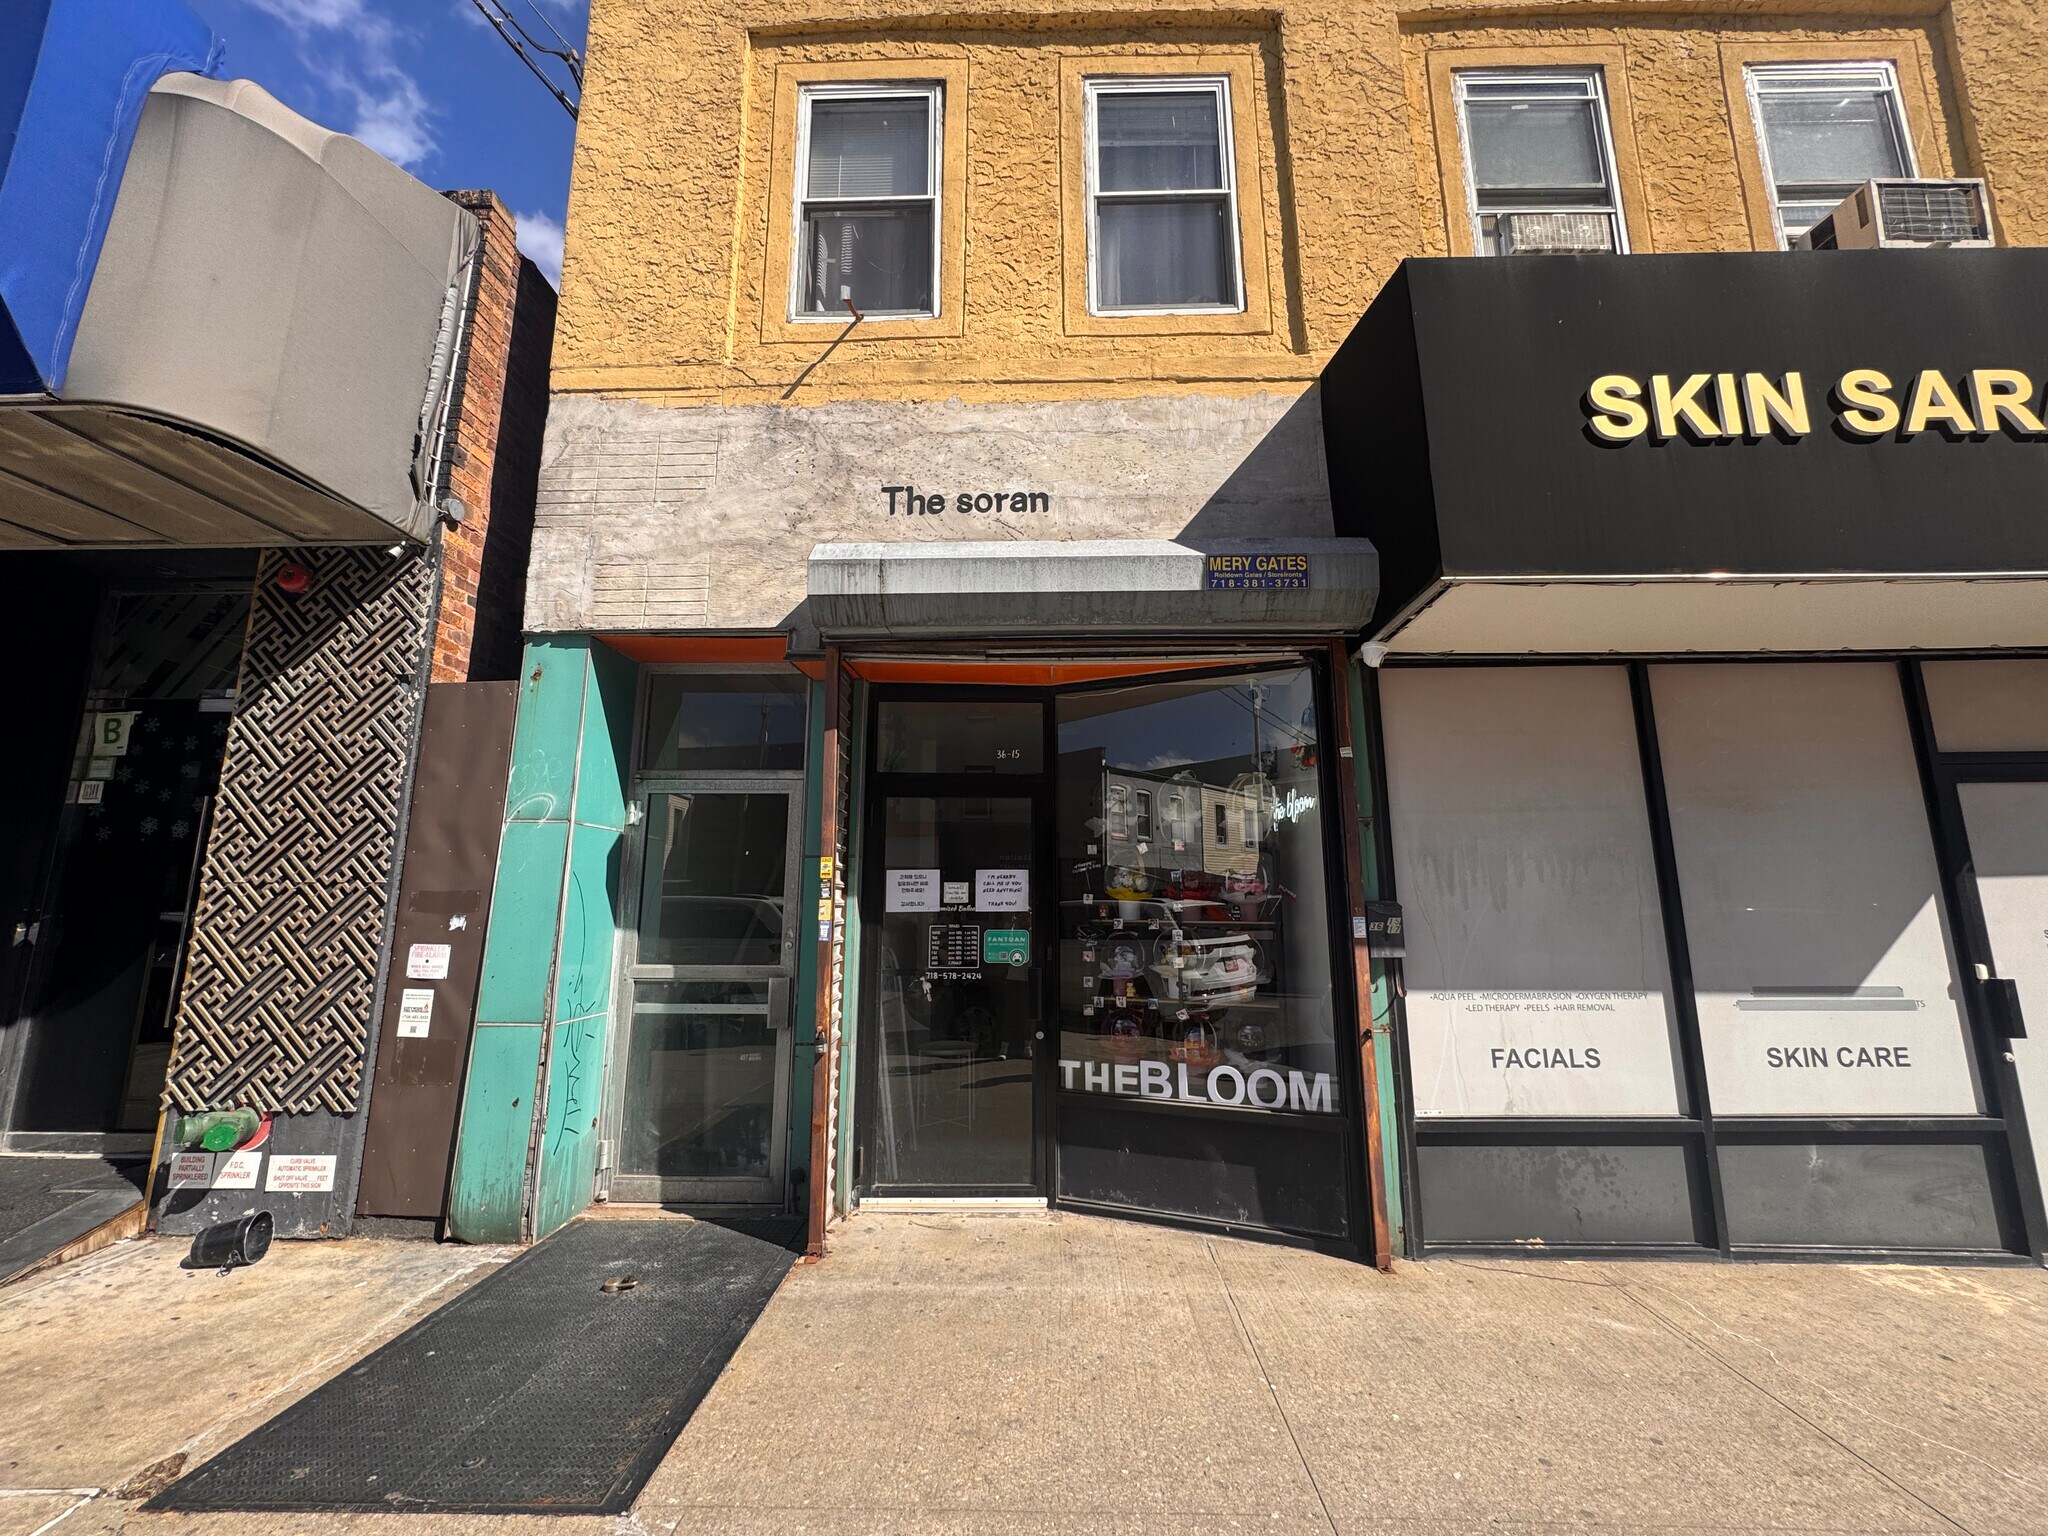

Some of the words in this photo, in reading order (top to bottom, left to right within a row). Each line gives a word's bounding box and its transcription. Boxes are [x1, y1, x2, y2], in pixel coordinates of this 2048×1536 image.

[1588, 372, 1811, 439] SKIN
[1836, 369, 2048, 436] SAR
[881, 486, 946, 516] The
[956, 492, 1049, 514] soran
[1209, 556, 1252, 571] MERY
[1256, 556, 1307, 571] GATES
[103, 718, 122, 744] B
[996, 749, 1020, 759] 36-15
[1370, 922, 1383, 930] 36
[925, 972, 982, 980] 718-578-2424
[1433, 993, 1457, 1001] AQUA
[1482, 992, 1572, 1000] MICRODERMABRASION
[1578, 992, 1611, 1000] OXYGEN
[1612, 992, 1648, 1000] THERAPY
[1467, 1004, 1484, 1012] LED
[1484, 1004, 1520, 1012] THERAPY
[1526, 1004, 1550, 1012] PEELS
[1556, 1004, 1576, 1012] HAIR
[1577, 1004, 1616, 1012] REMOVAL
[1491, 1048, 1601, 1069] FACIALS
[1766, 1046, 1829, 1068] SKIN
[1836, 1046, 1912, 1068] CARE
[178, 1164, 205, 1172] PARTIALLY
[172, 1173, 209, 1181] SPRINKLERED
[220, 1171, 251, 1179] SPRINKLER
